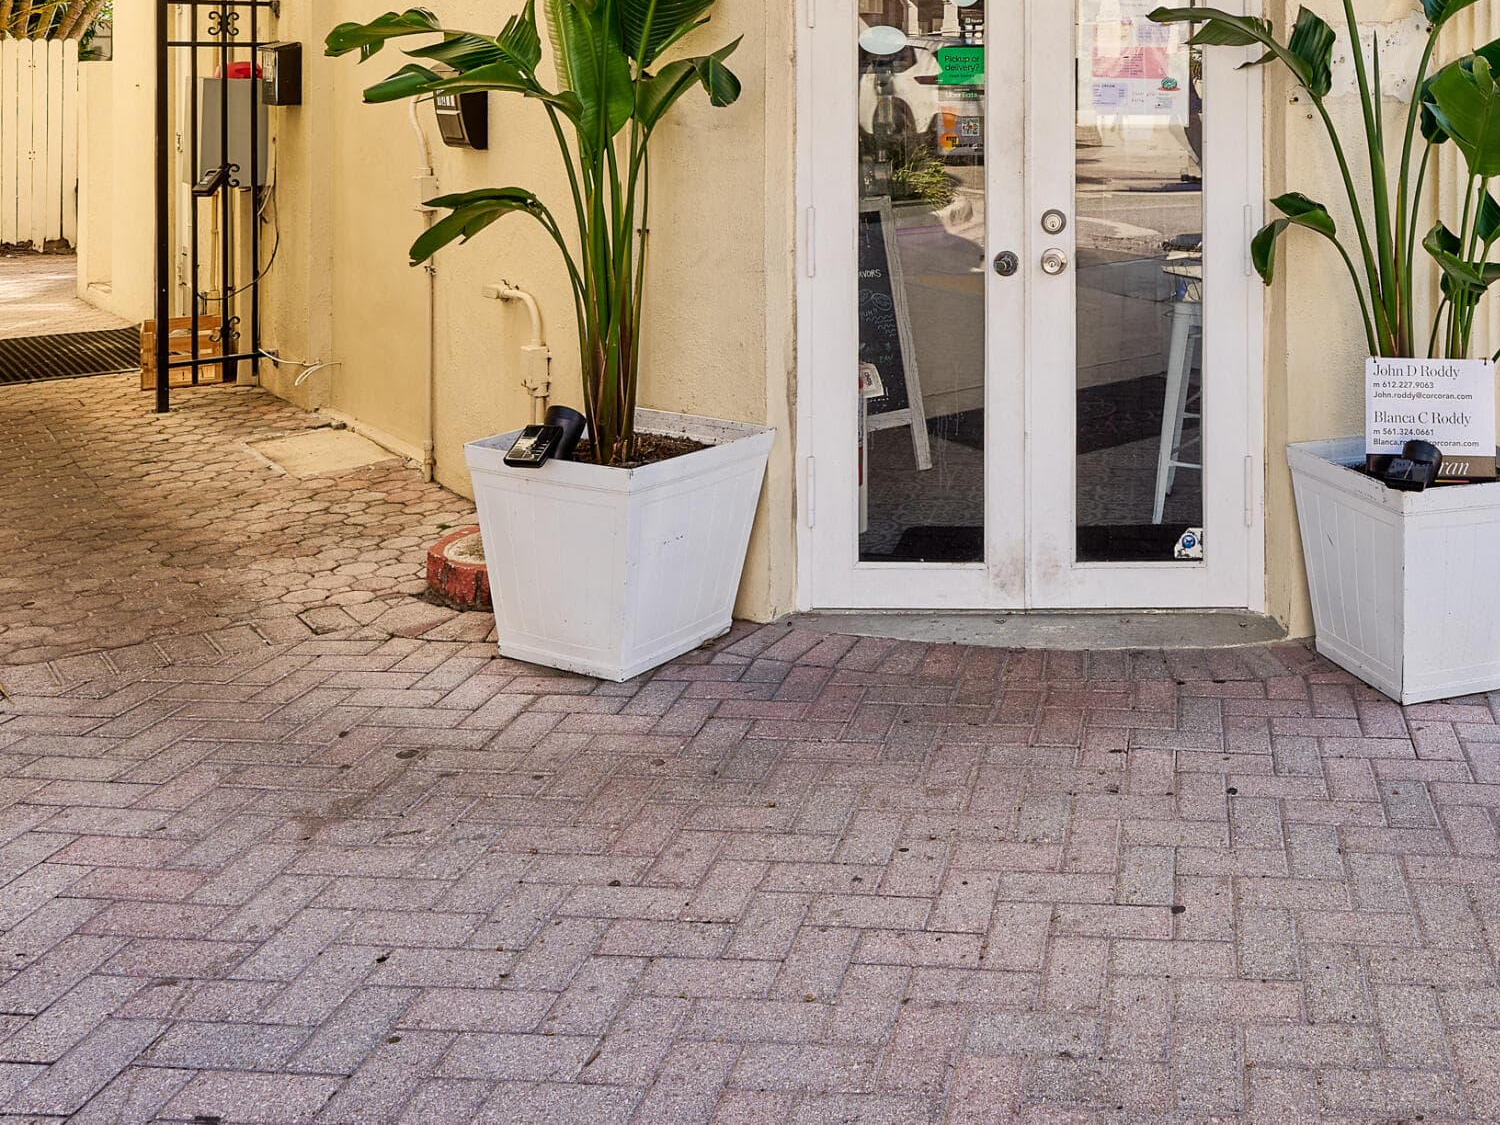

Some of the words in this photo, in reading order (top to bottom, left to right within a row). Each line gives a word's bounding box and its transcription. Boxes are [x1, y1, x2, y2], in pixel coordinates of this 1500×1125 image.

[944, 55, 970, 64] Pickup
[944, 64, 979, 72] delivery?
[1373, 364, 1403, 377] John
[1407, 365, 1417, 377] D
[1420, 365, 1460, 380] Roddy
[1382, 381, 1434, 389] 612.227.9063
[1373, 391, 1473, 401] John.roddy@corcoran.com
[1373, 410, 1415, 423] Blanca
[1418, 411, 1429, 424] C
[1432, 412, 1472, 427] Roddy
[1382, 428, 1434, 436] 561.324.0661
[1438, 461, 1469, 475] ran
